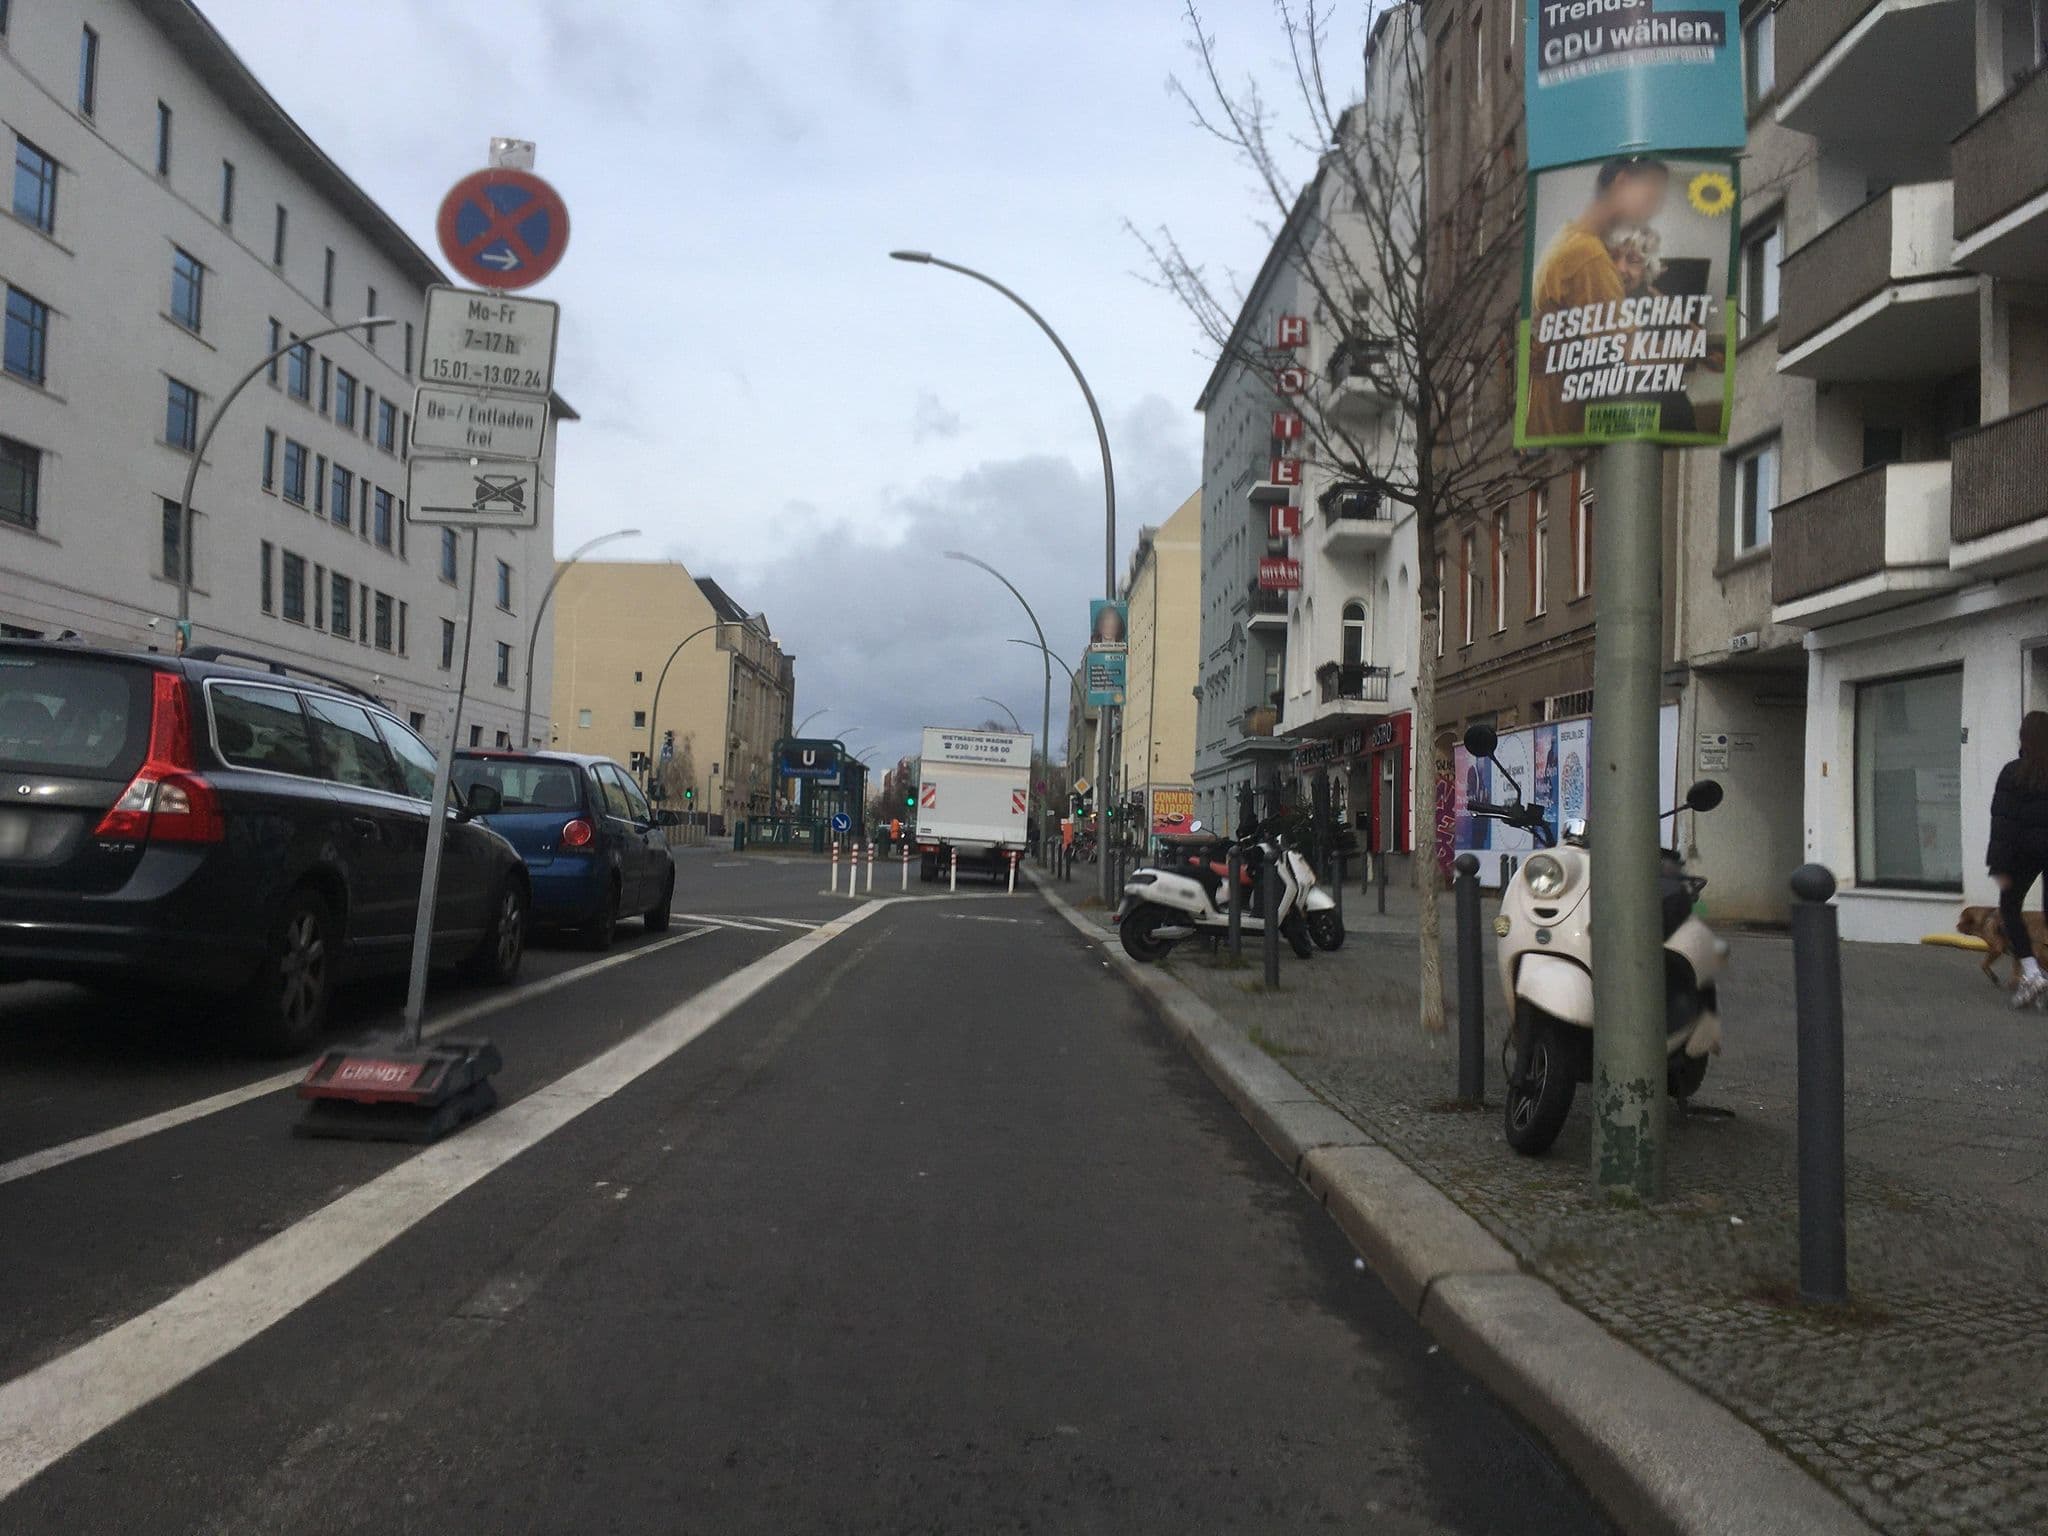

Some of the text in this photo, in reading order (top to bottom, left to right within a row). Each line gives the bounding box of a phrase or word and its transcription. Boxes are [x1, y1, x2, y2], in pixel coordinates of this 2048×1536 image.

[1543, 17, 1720, 65] CDU wählen.
[1538, 295, 1719, 344] GESELLSCHAFT-
[1545, 329, 1707, 375] LICHES KLIMA
[1561, 362, 1687, 403] SCHÜTZEN.
[466, 429, 493, 447] frei
[468, 406, 534, 430] Entladen
[1278, 320, 1303, 535] HOTEL
[802, 750, 816, 766] U
[974, 744, 988, 752] 312
